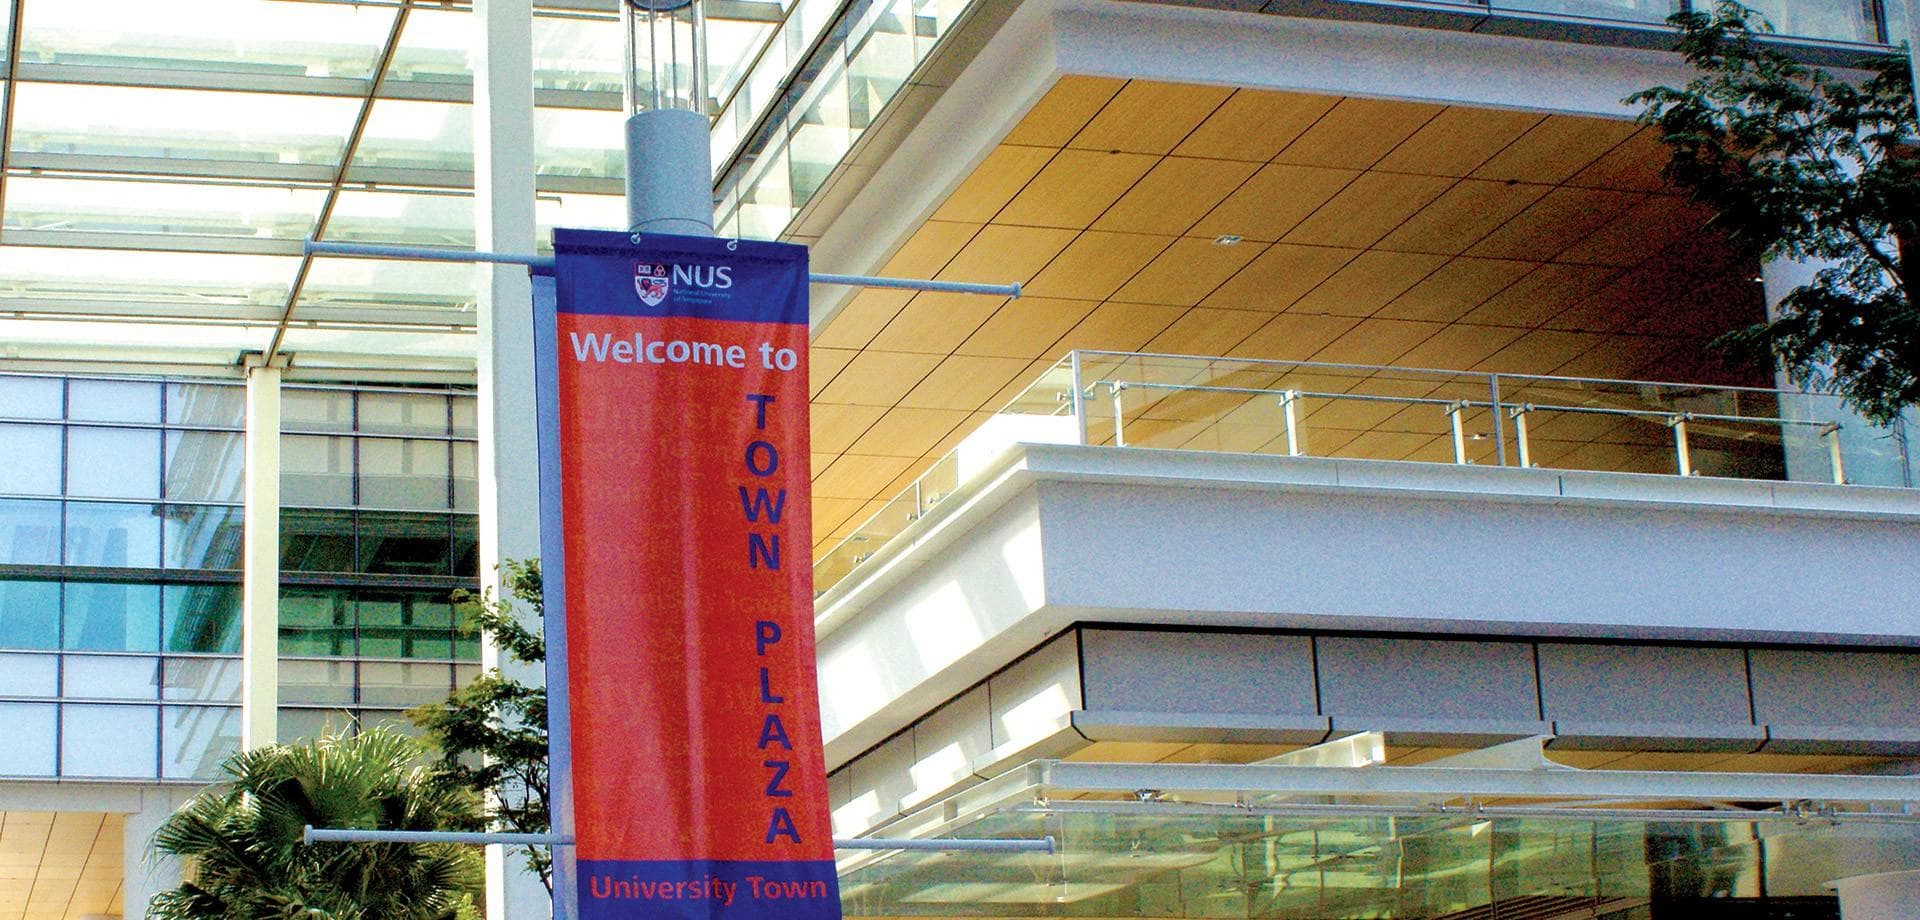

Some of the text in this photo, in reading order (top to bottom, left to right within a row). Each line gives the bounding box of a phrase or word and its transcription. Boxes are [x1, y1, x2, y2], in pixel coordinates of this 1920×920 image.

[673, 264, 732, 289] NUS
[570, 332, 798, 371] Welcome to
[738, 393, 801, 844] TOWN PLAZA
[590, 874, 827, 906] University Town
